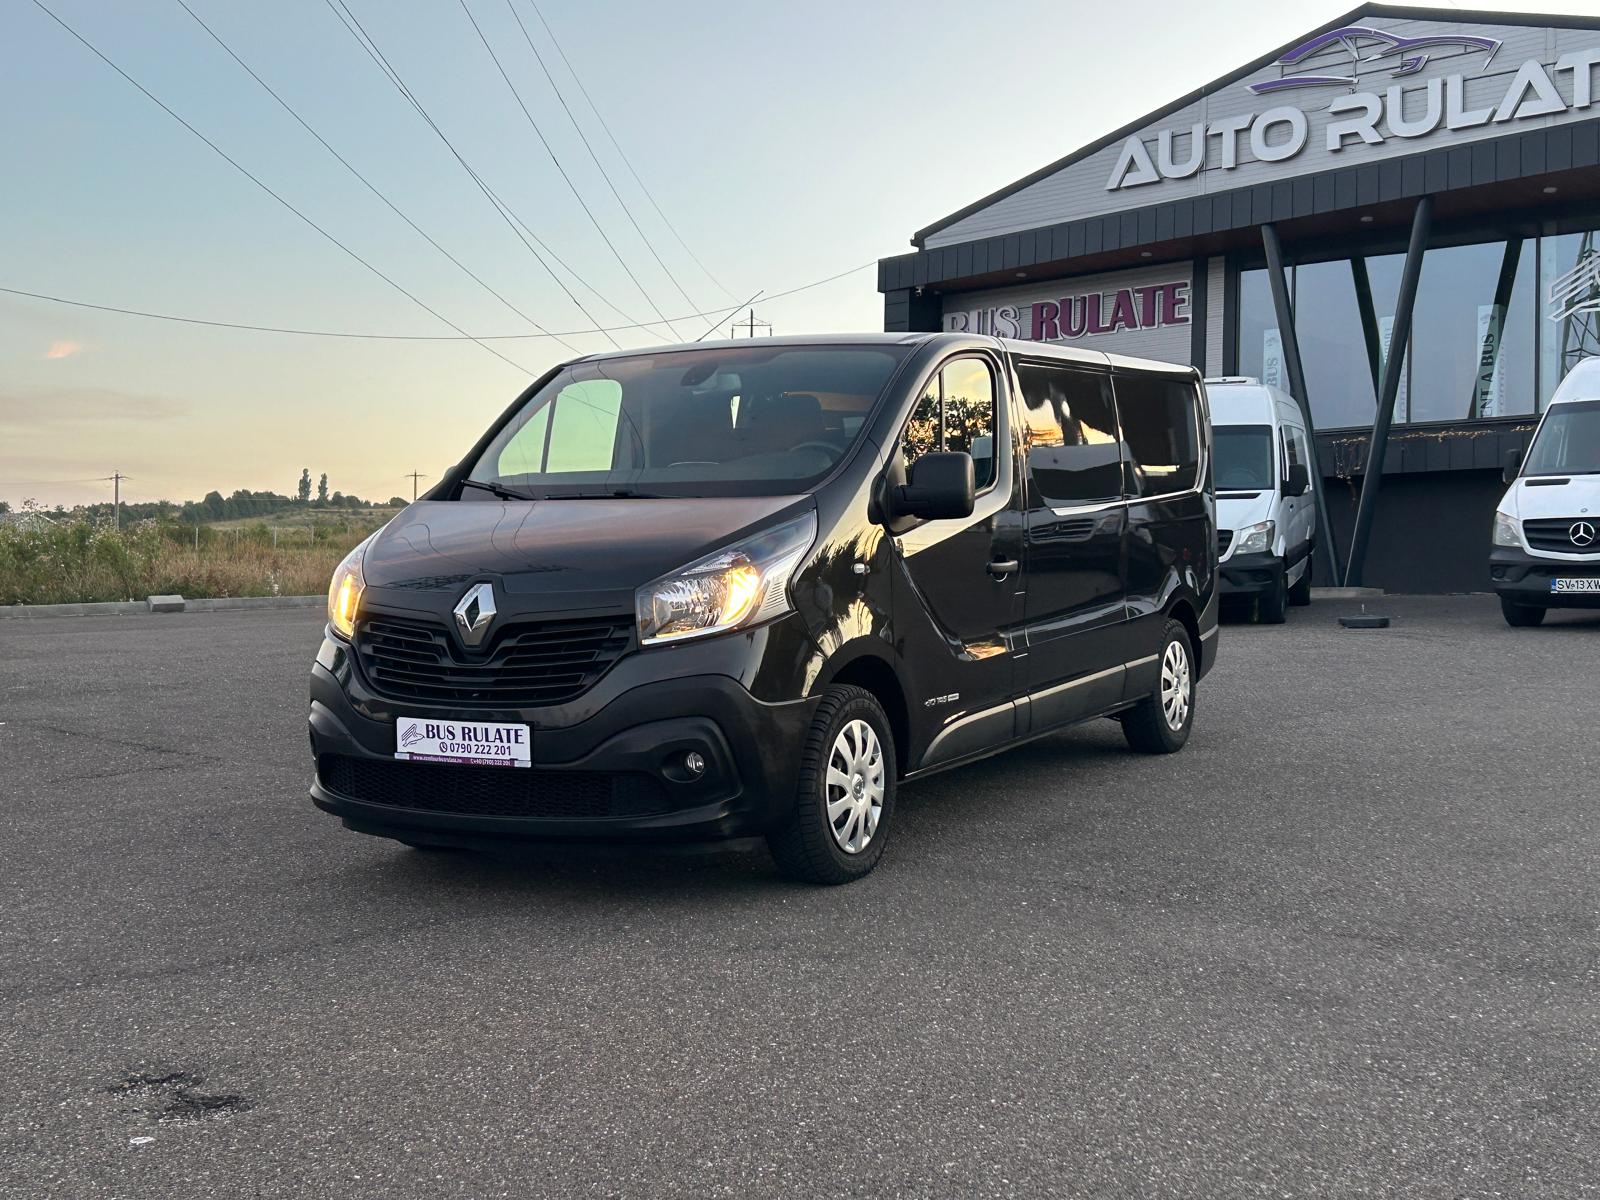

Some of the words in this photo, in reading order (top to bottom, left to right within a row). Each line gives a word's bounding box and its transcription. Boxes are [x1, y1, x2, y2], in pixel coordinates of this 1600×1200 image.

[1105, 106, 1308, 190] AUTO
[943, 305, 1021, 340] BUS
[1030, 279, 1192, 342] RULATE
[1481, 333, 1495, 367] BUS
[425, 723, 456, 741] BUS
[461, 726, 525, 745] RULATE
[449, 742, 472, 754] 0790
[474, 744, 492, 755] 222
[494, 745, 511, 756] 201
